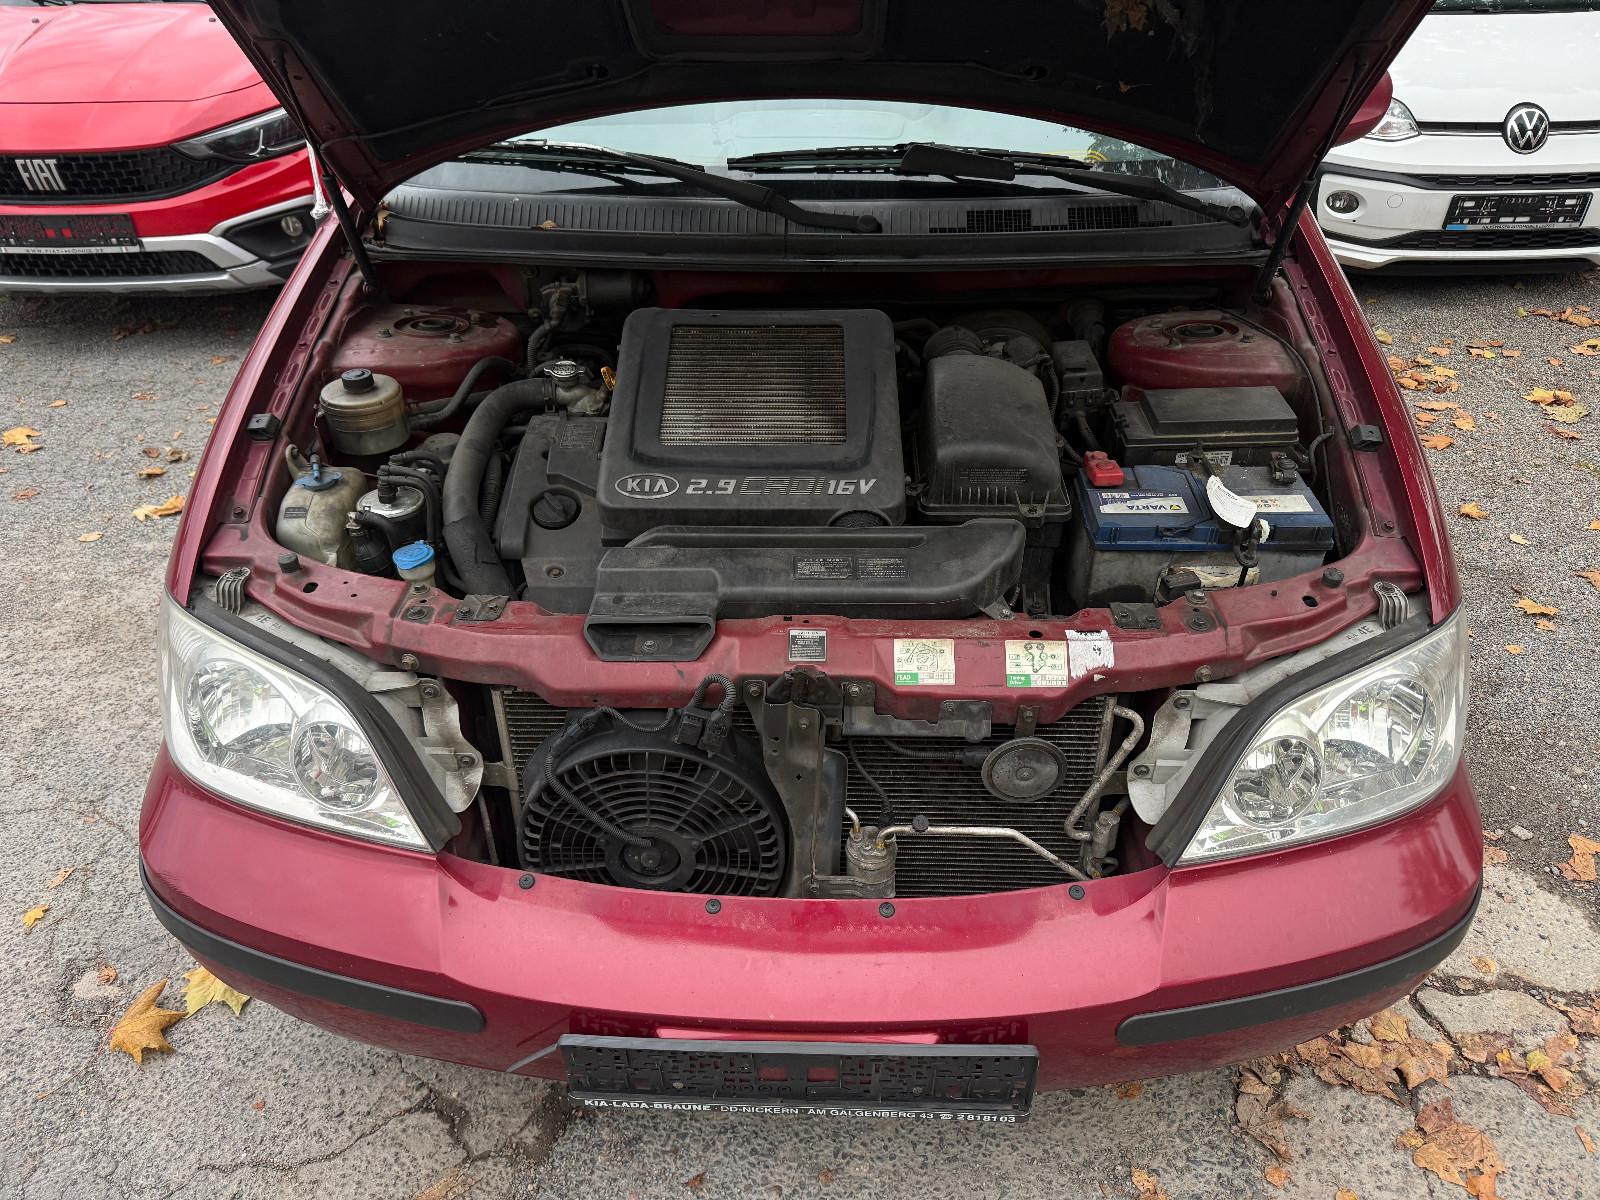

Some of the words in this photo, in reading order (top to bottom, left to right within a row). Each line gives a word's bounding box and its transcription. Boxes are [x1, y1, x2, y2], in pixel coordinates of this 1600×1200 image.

[15, 158, 67, 191] FIAT
[626, 478, 669, 493] KIA
[686, 478, 737, 495] 2.9
[827, 478, 878, 495] 16V
[584, 1099, 712, 1112] KIA-LADA-BRAUNE
[720, 1105, 799, 1115] DD-NICKERN
[807, 1108, 826, 1116] AM
[830, 1109, 916, 1119] GALGENBERG
